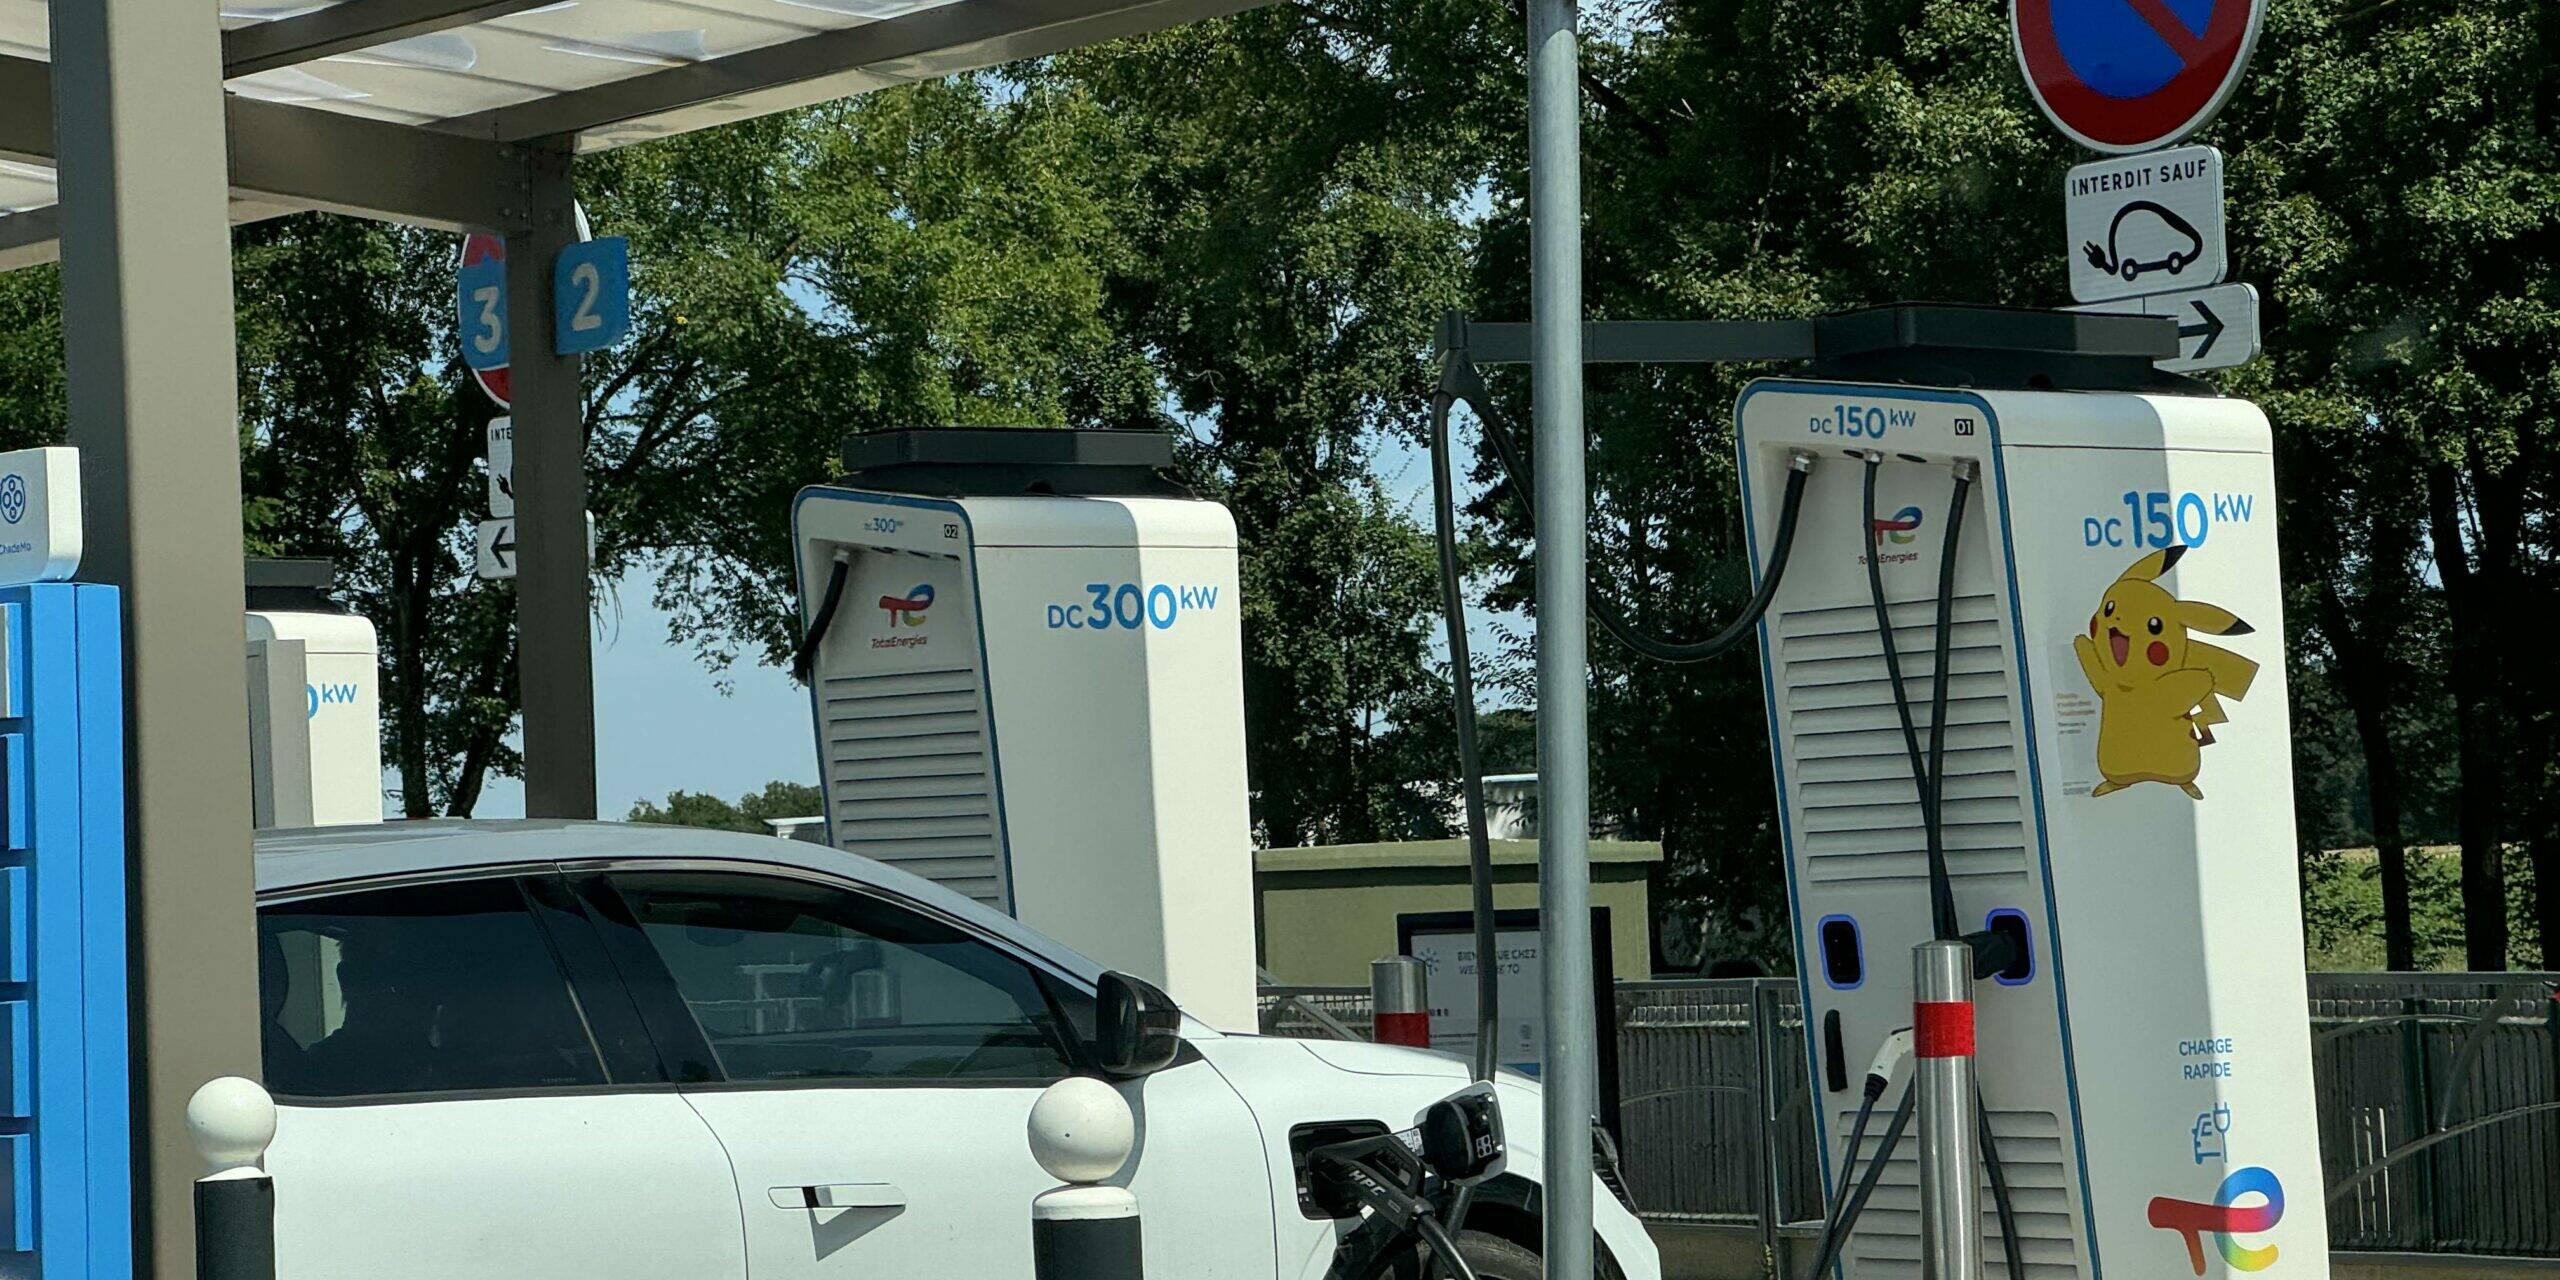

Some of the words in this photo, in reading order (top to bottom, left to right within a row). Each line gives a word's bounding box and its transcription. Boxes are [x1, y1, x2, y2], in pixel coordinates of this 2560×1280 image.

[2072, 168, 2151, 197] INTERDIT
[2160, 159, 2208, 183] SAUF
[571, 262, 602, 332] 2
[473, 285, 501, 353] 3
[1956, 420, 1973, 434] 01
[944, 525, 957, 538] 02
[2178, 1038, 2233, 1056] CHARGE
[2184, 1062, 2232, 1080] RAPIDE
[1348, 1169, 1387, 1196] HPC
